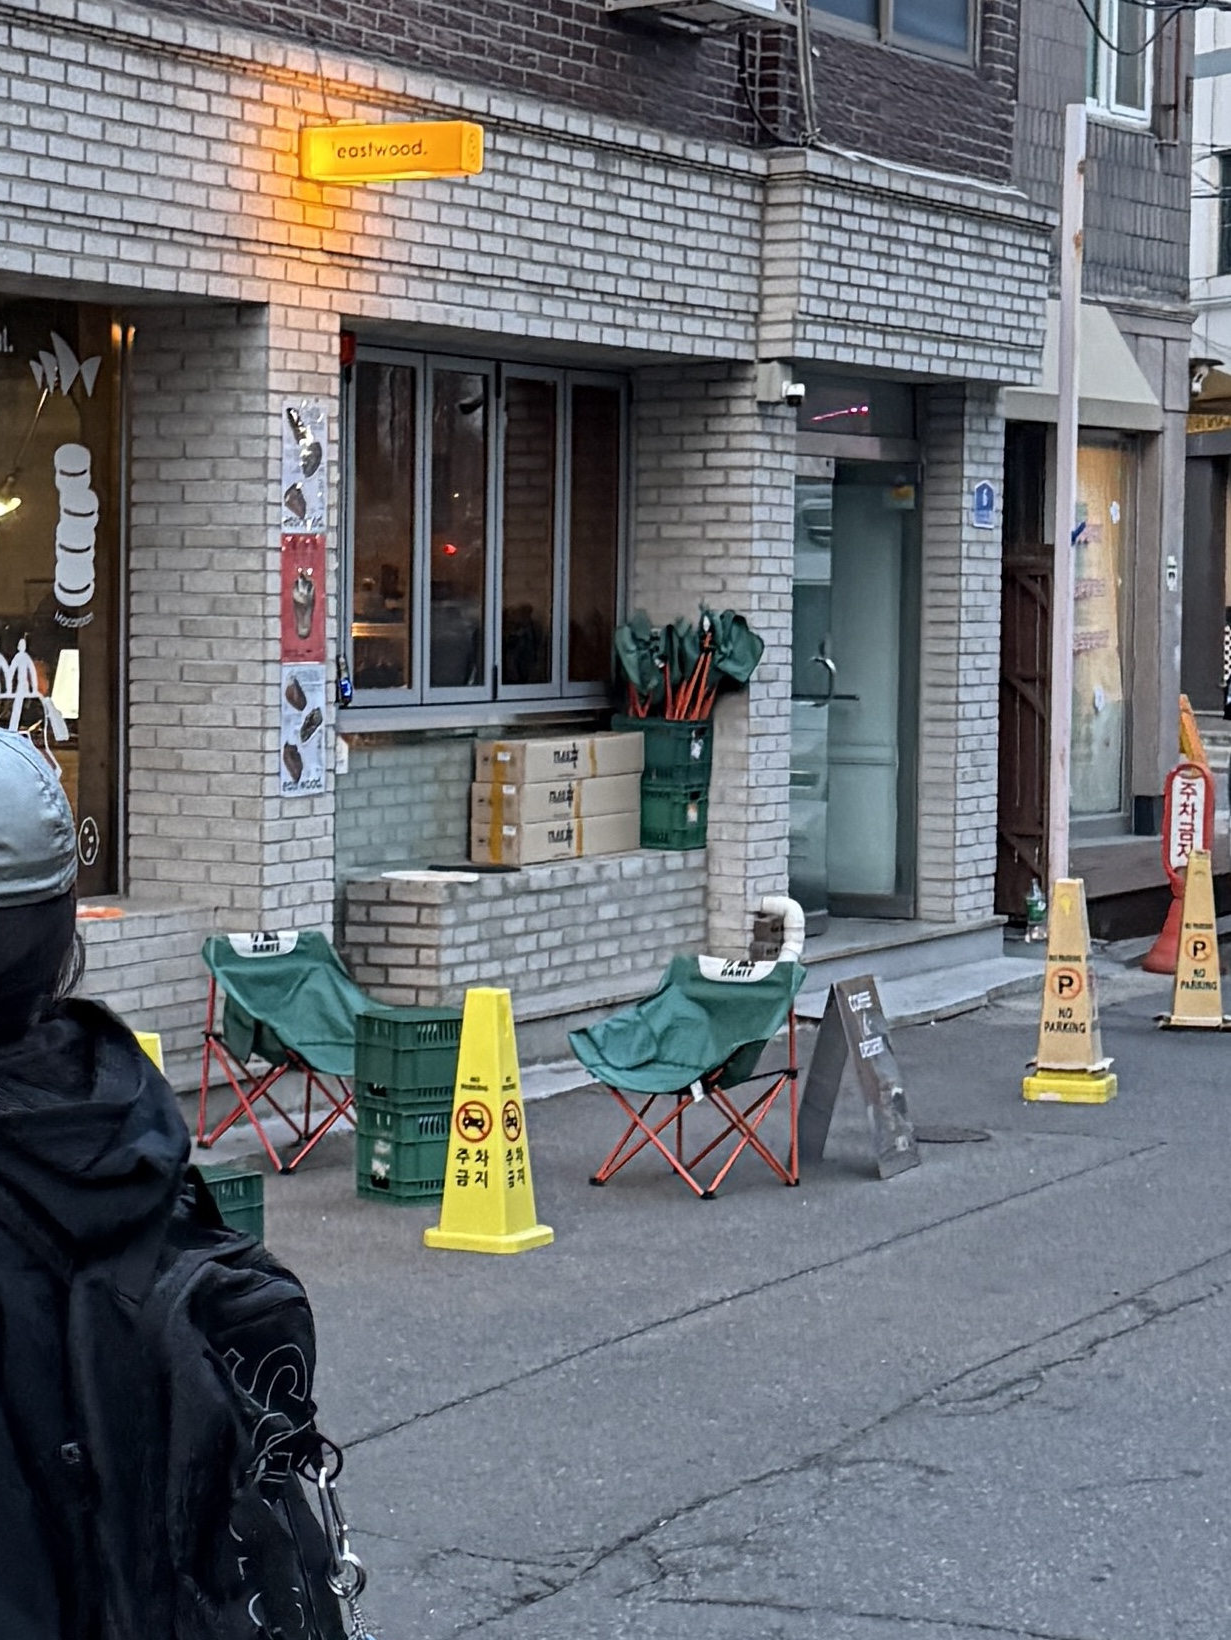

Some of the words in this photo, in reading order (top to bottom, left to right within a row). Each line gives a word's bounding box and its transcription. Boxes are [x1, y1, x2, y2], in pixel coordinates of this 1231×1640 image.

[1176, 781, 1198, 857] 주차금지
[1058, 975, 1074, 994] P
[1058, 1007, 1073, 1019] NO
[1044, 1021, 1086, 1034] PARKING
[456, 1147, 489, 1167] 주차
[455, 1169, 488, 1189] 금지
